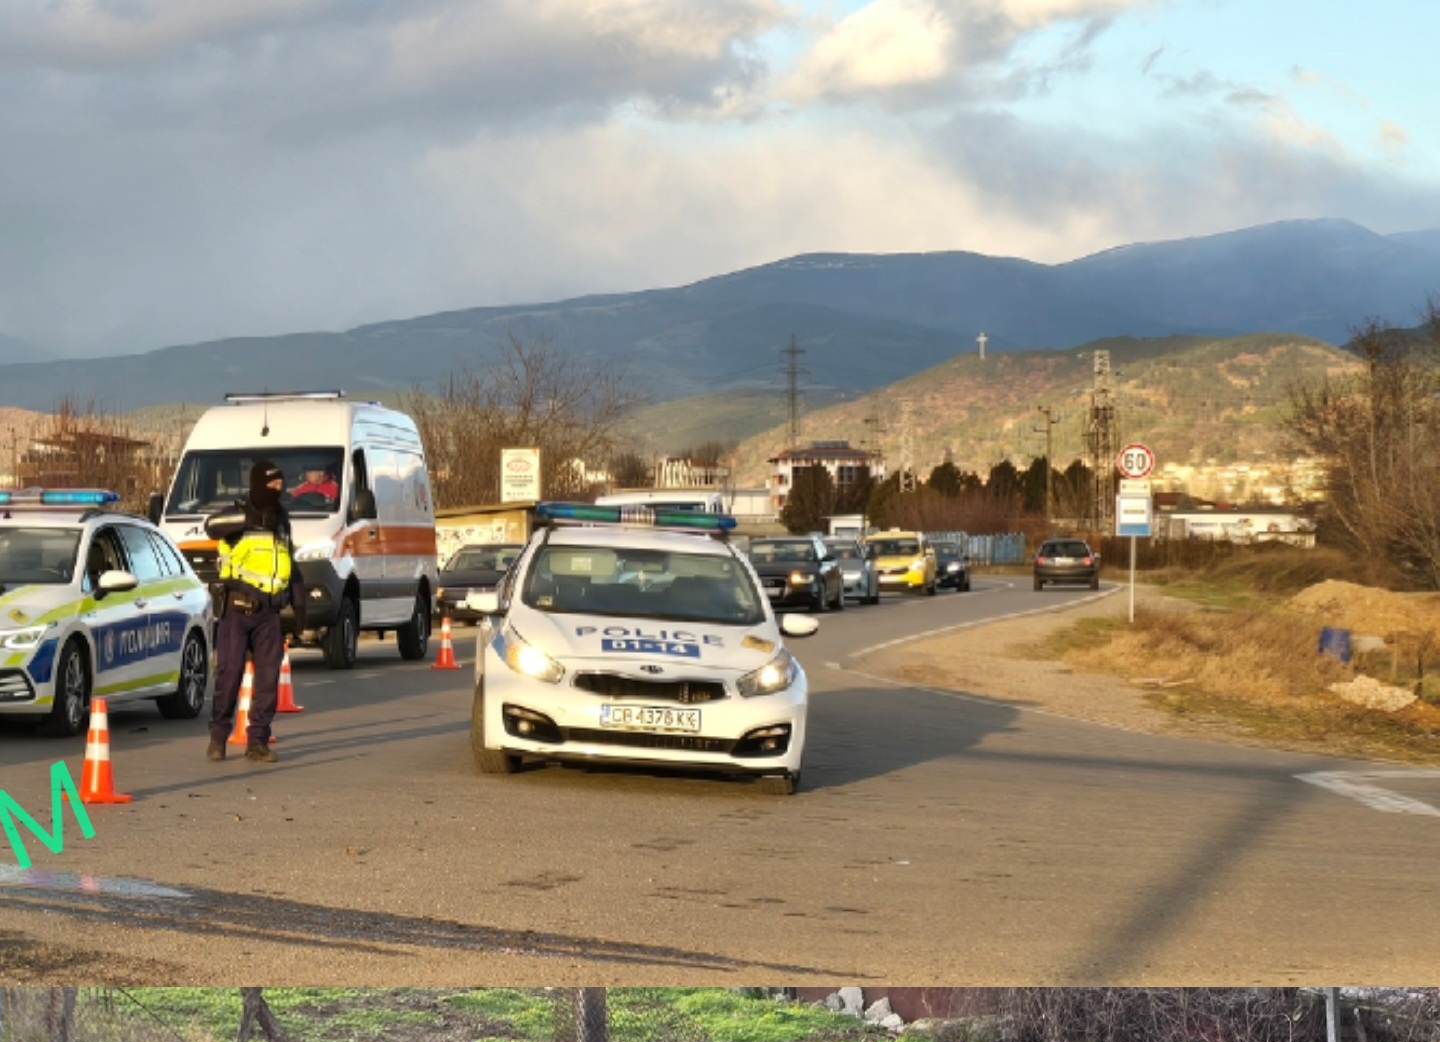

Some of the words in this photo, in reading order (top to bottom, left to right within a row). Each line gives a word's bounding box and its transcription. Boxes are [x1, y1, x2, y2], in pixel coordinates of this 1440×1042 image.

[1123, 452, 1147, 471] 60
[575, 626, 725, 648] POLICE
[611, 640, 688, 653] 01-14
